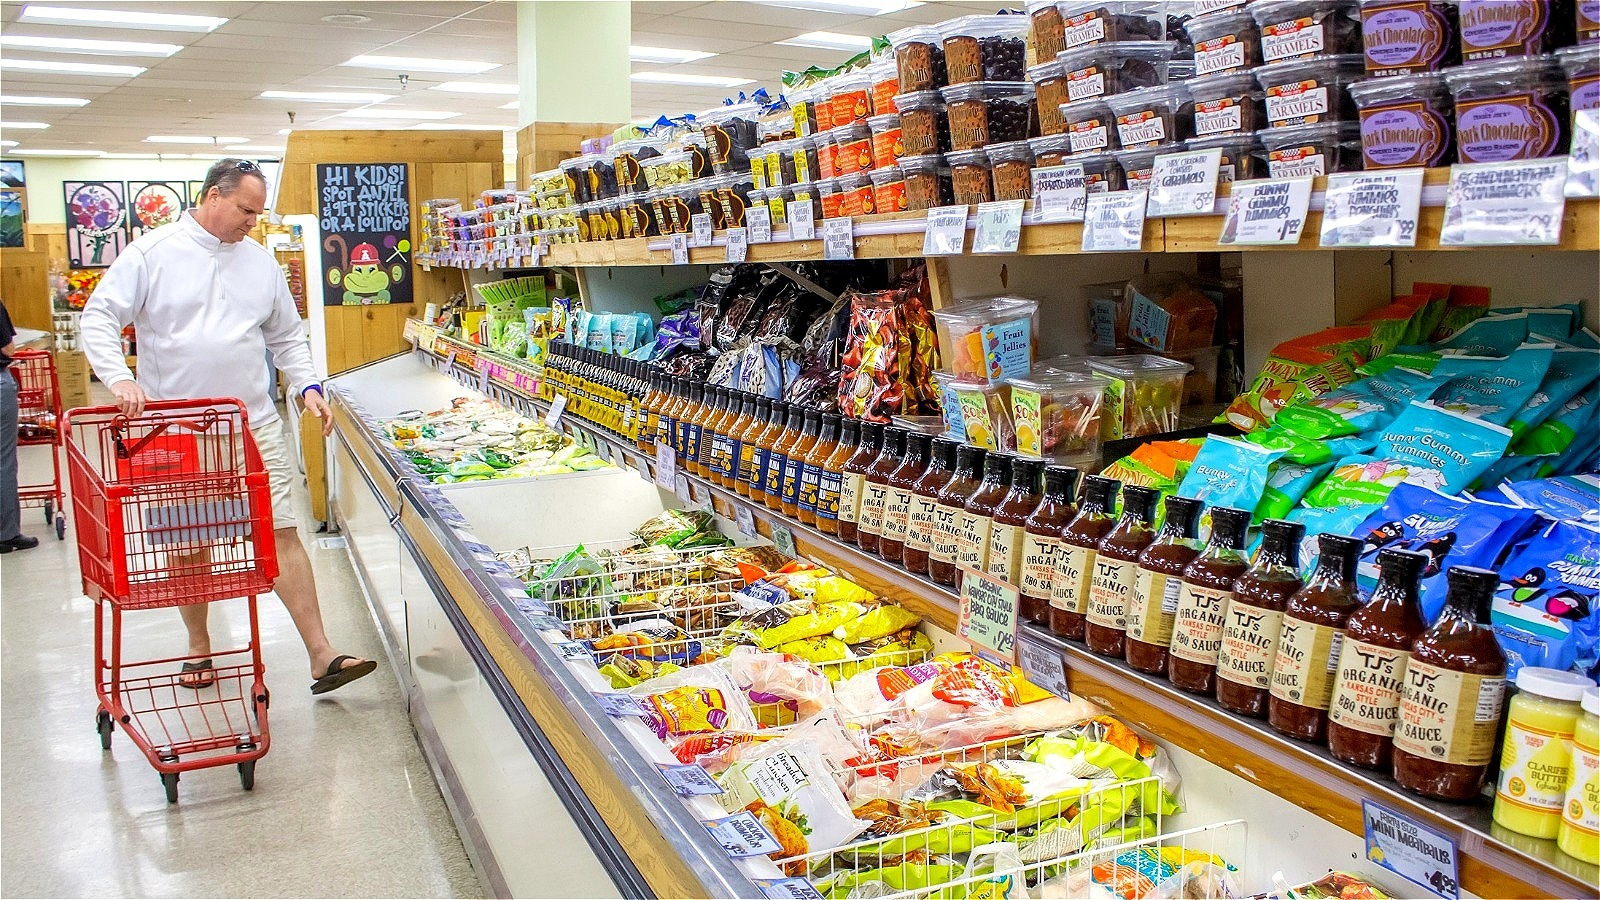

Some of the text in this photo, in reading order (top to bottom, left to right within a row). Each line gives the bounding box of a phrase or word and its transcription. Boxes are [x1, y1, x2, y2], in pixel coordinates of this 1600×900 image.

[325, 165, 404, 186] HI KIDS!
[323, 186, 355, 202] SPOT
[360, 201, 409, 217] STICKERS
[1248, 195, 1288, 209] GUMMY
[321, 217, 409, 232] OR A LOLLIPOP
[1003, 330, 1024, 341] Fruit
[1002, 341, 1026, 354] Jellies
[1391, 444, 1446, 468] Tummies
[1420, 435, 1472, 466] Gummy
[1025, 575, 1038, 587] BBQ
[1093, 576, 1128, 595] RGANIC
[1096, 604, 1124, 616] SAUCE
[1180, 608, 1226, 629] ORGANI
[1182, 620, 1221, 634] KANSAS CITY
[1189, 629, 1208, 639] STYLE
[1191, 638, 1221, 652] SAUC
[1246, 644, 1260, 654] CITY
[1230, 649, 1247, 660] STYLE
[1232, 659, 1266, 673] SAUCE
[1343, 669, 1402, 693] ORGANIC
[1346, 682, 1394, 699] KANSAS CITY
[1338, 694, 1398, 720] BBQ SAUCE
[1356, 694, 1378, 706] STYLE
[1403, 686, 1449, 714] RGANIC
[1419, 706, 1436, 718] CITY
[1404, 724, 1442, 742] SAUCE
[765, 757, 790, 793] Chicken
[777, 753, 805, 784] Breaded
[1527, 761, 1568, 776] CLARIFIE
[1531, 771, 1568, 783] BUTTER
[1371, 816, 1395, 840] MINI
[1398, 828, 1451, 865] MEATBALLS
